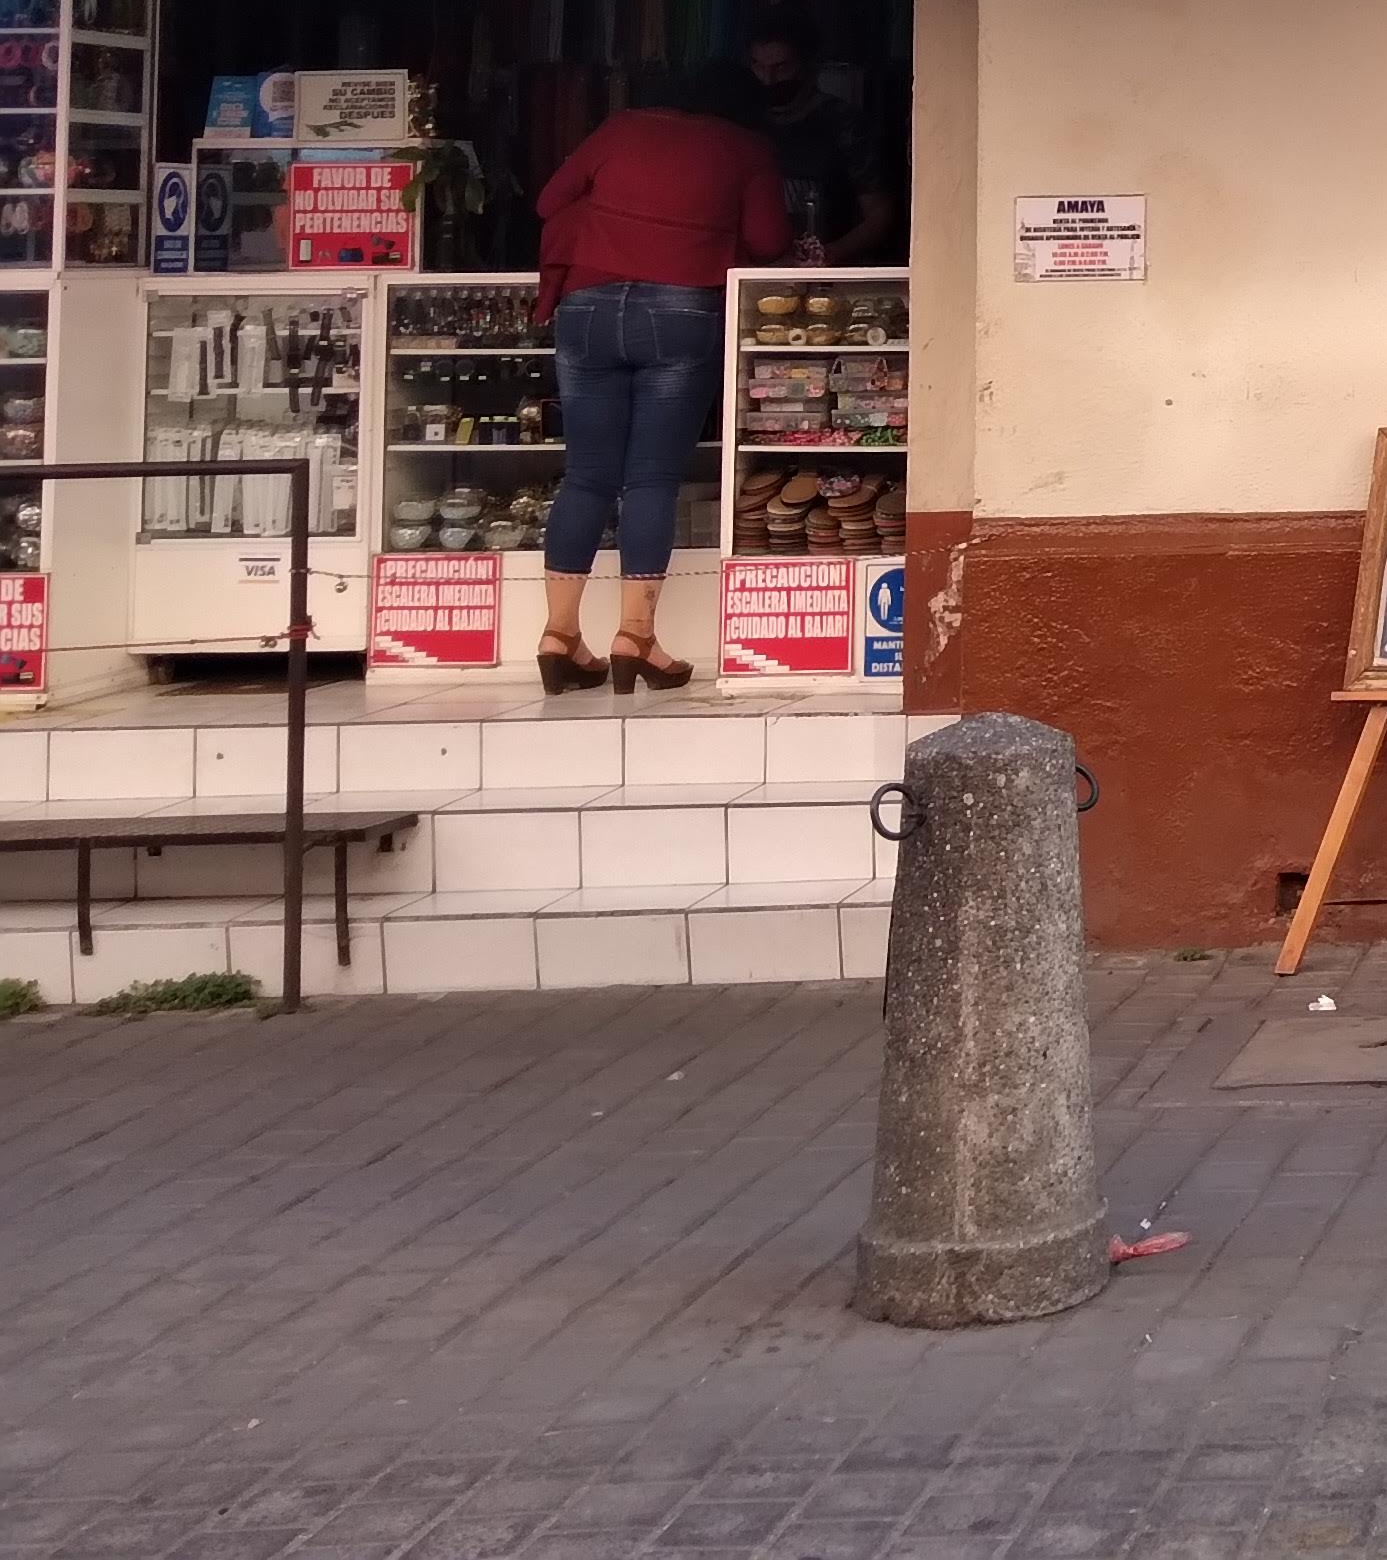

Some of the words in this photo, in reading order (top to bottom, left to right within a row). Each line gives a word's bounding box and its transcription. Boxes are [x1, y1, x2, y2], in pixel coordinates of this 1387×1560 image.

[331, 88, 348, 96] SU
[351, 87, 396, 96] CAMBIO
[313, 167, 367, 188] FAVOR
[371, 167, 392, 188] DE
[295, 189, 315, 210] NO
[317, 189, 378, 210] OLVIDAR
[1056, 200, 1105, 213] AMAYA
[295, 212, 408, 234] PERTENENCIAS
[244, 564, 276, 577] VISA
[0, 579, 25, 601] DE
[376, 585, 437, 607] ESCALERA
[438, 584, 495, 607] IMEDIATA
[726, 591, 788, 614] ESCALERA
[790, 590, 848, 613] IMEDIATA
[11, 602, 43, 626] SUS
[375, 608, 435, 633] ¡CUIDADO
[435, 608, 450, 631] AL
[451, 607, 495, 631] BAJAR!
[726, 616, 786, 642] ¡CUIDADO
[787, 616, 803, 638] AL
[804, 615, 848, 638] BAJAR!
